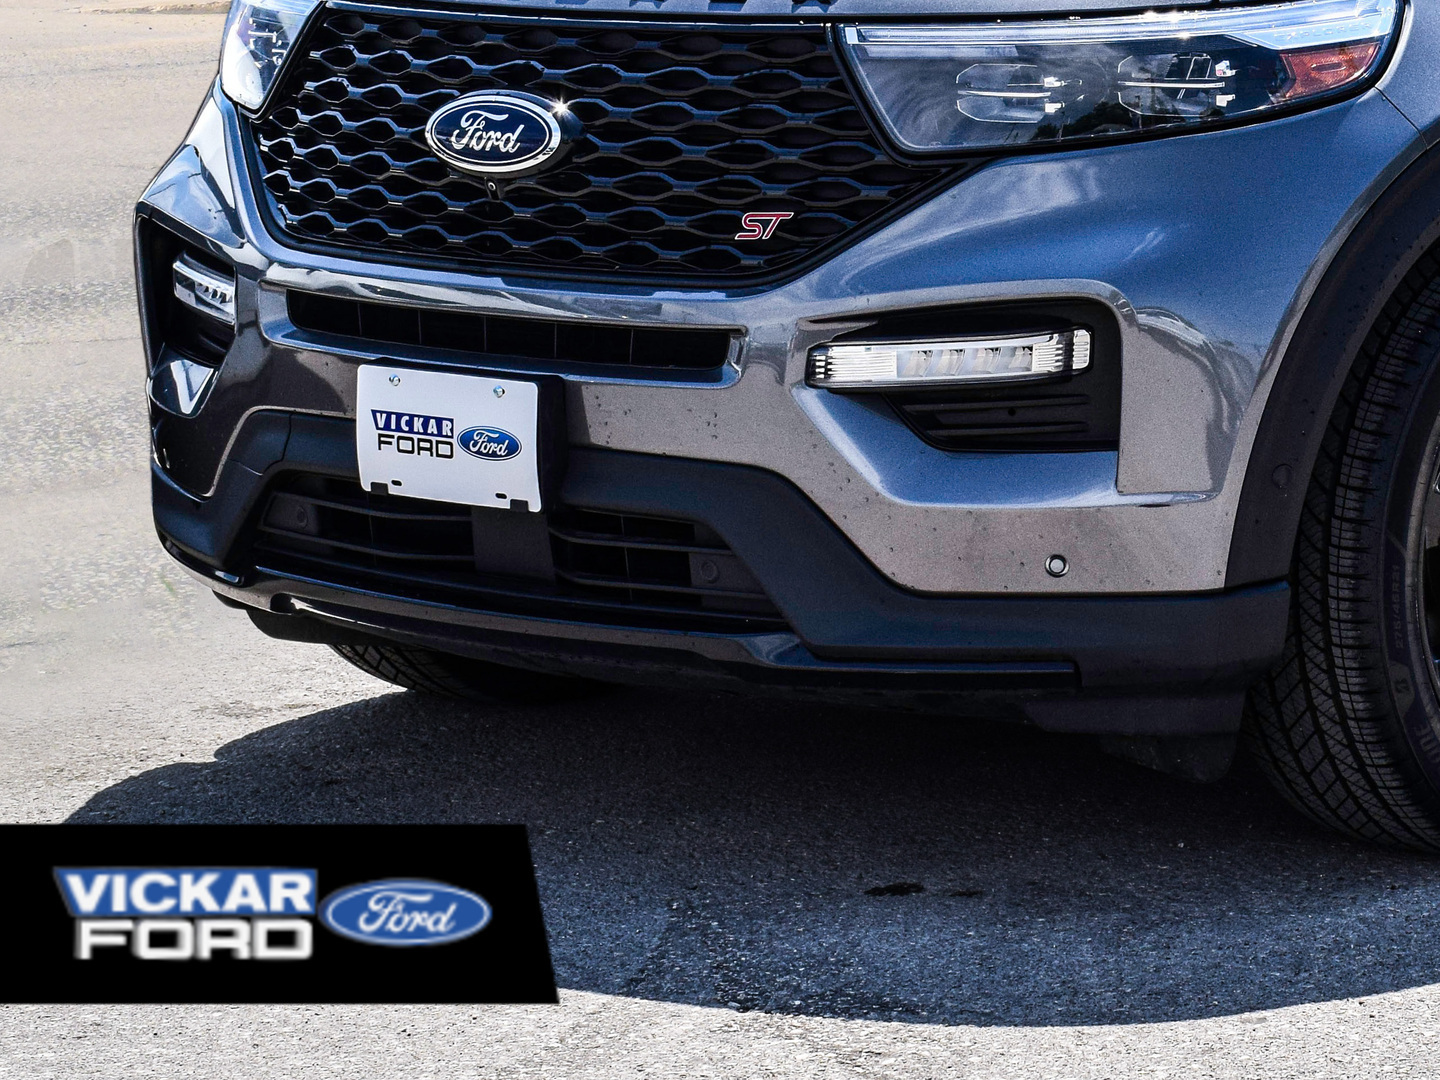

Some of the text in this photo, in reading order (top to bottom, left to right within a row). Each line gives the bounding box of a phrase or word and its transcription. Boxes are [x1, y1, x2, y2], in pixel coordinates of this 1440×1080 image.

[451, 110, 525, 154] Ford
[734, 211, 795, 240] ST
[375, 412, 454, 437] VICKAR
[377, 429, 509, 460] FORD Ford
